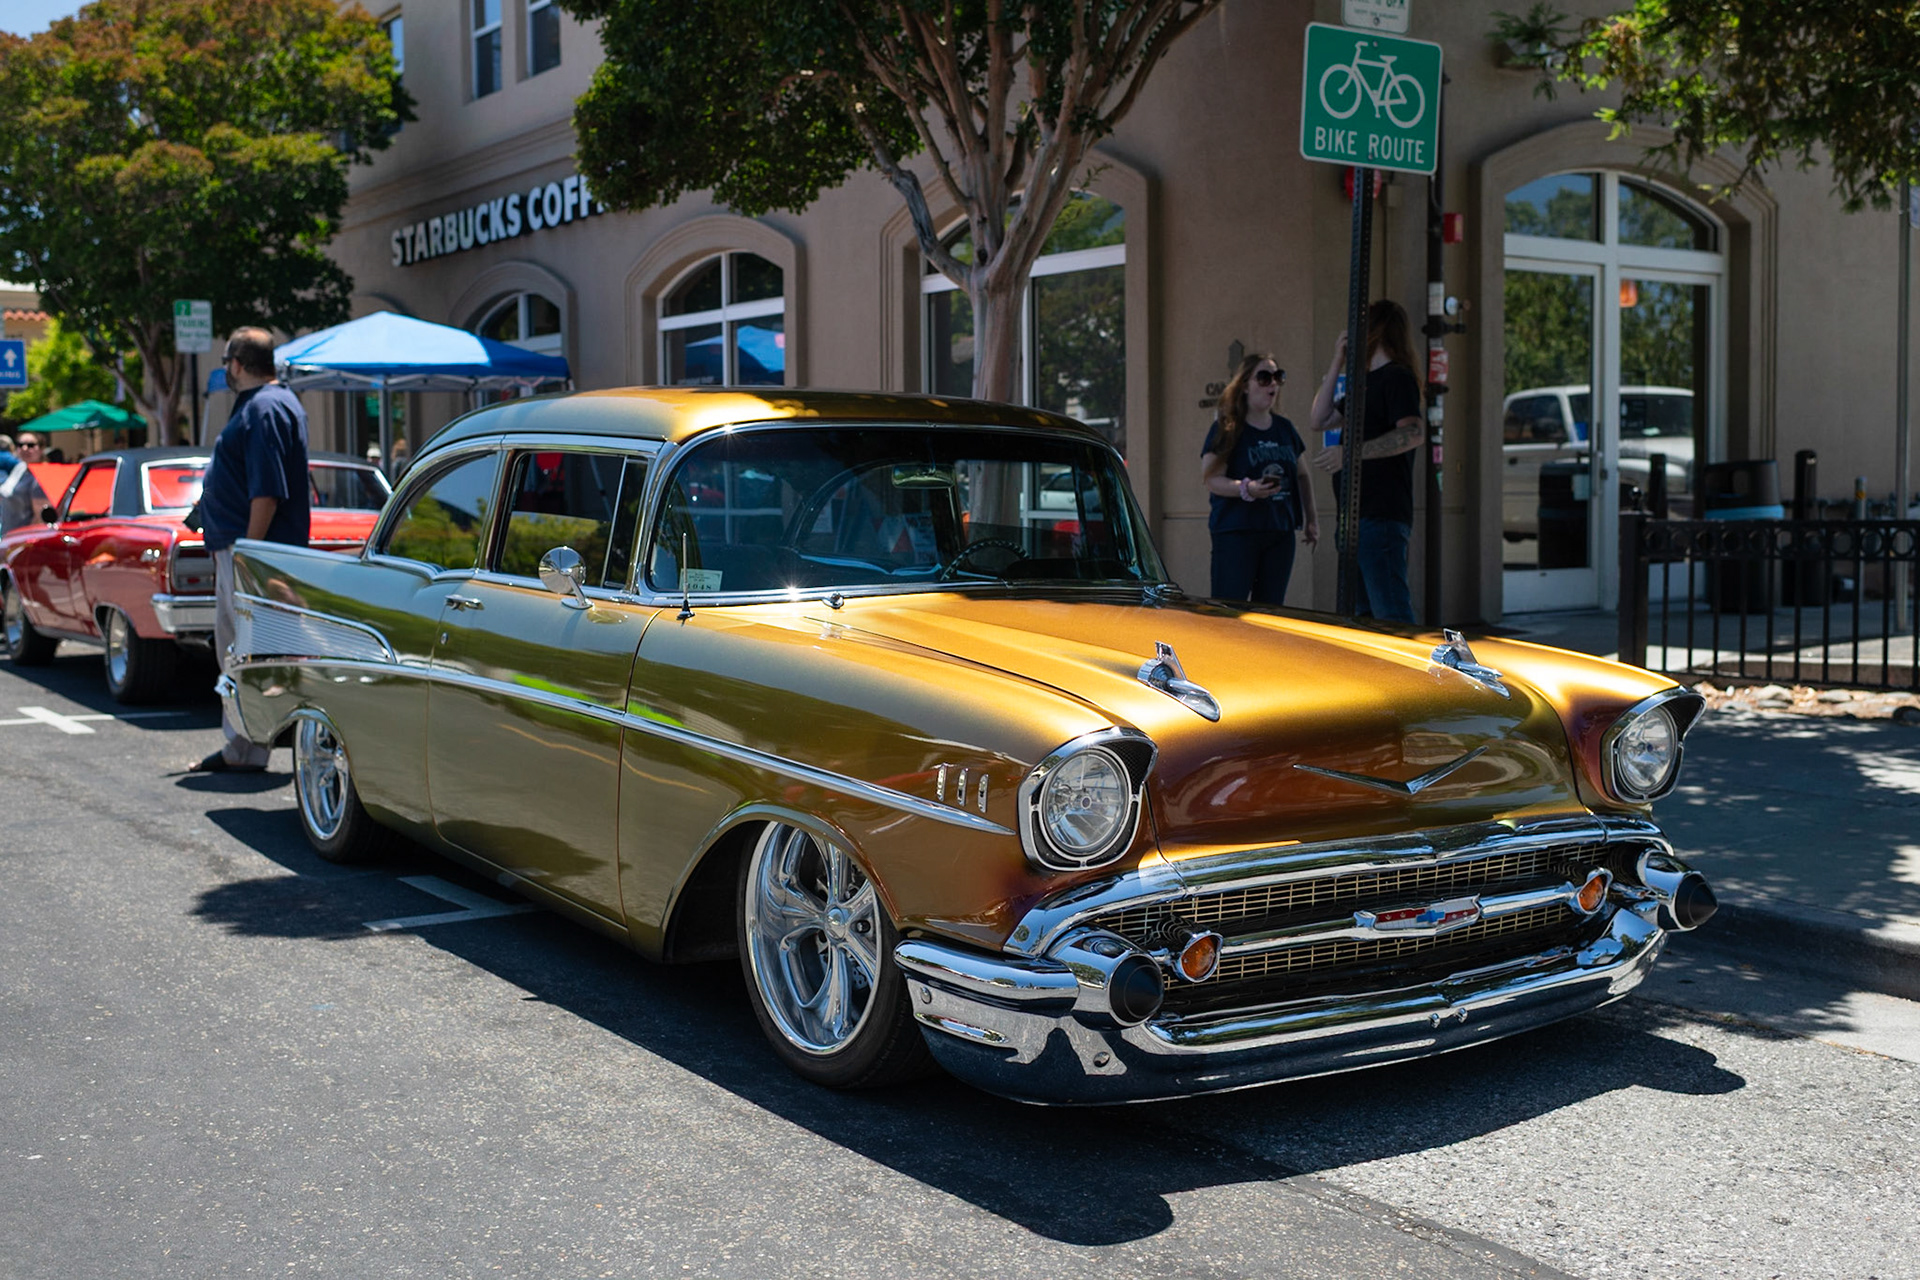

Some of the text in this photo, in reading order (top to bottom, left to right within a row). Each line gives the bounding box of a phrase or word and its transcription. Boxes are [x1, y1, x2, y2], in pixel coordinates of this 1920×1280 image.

[1314, 125, 1426, 165] BIKE ROUTE
[391, 173, 611, 268] STARBUCKS COFF
